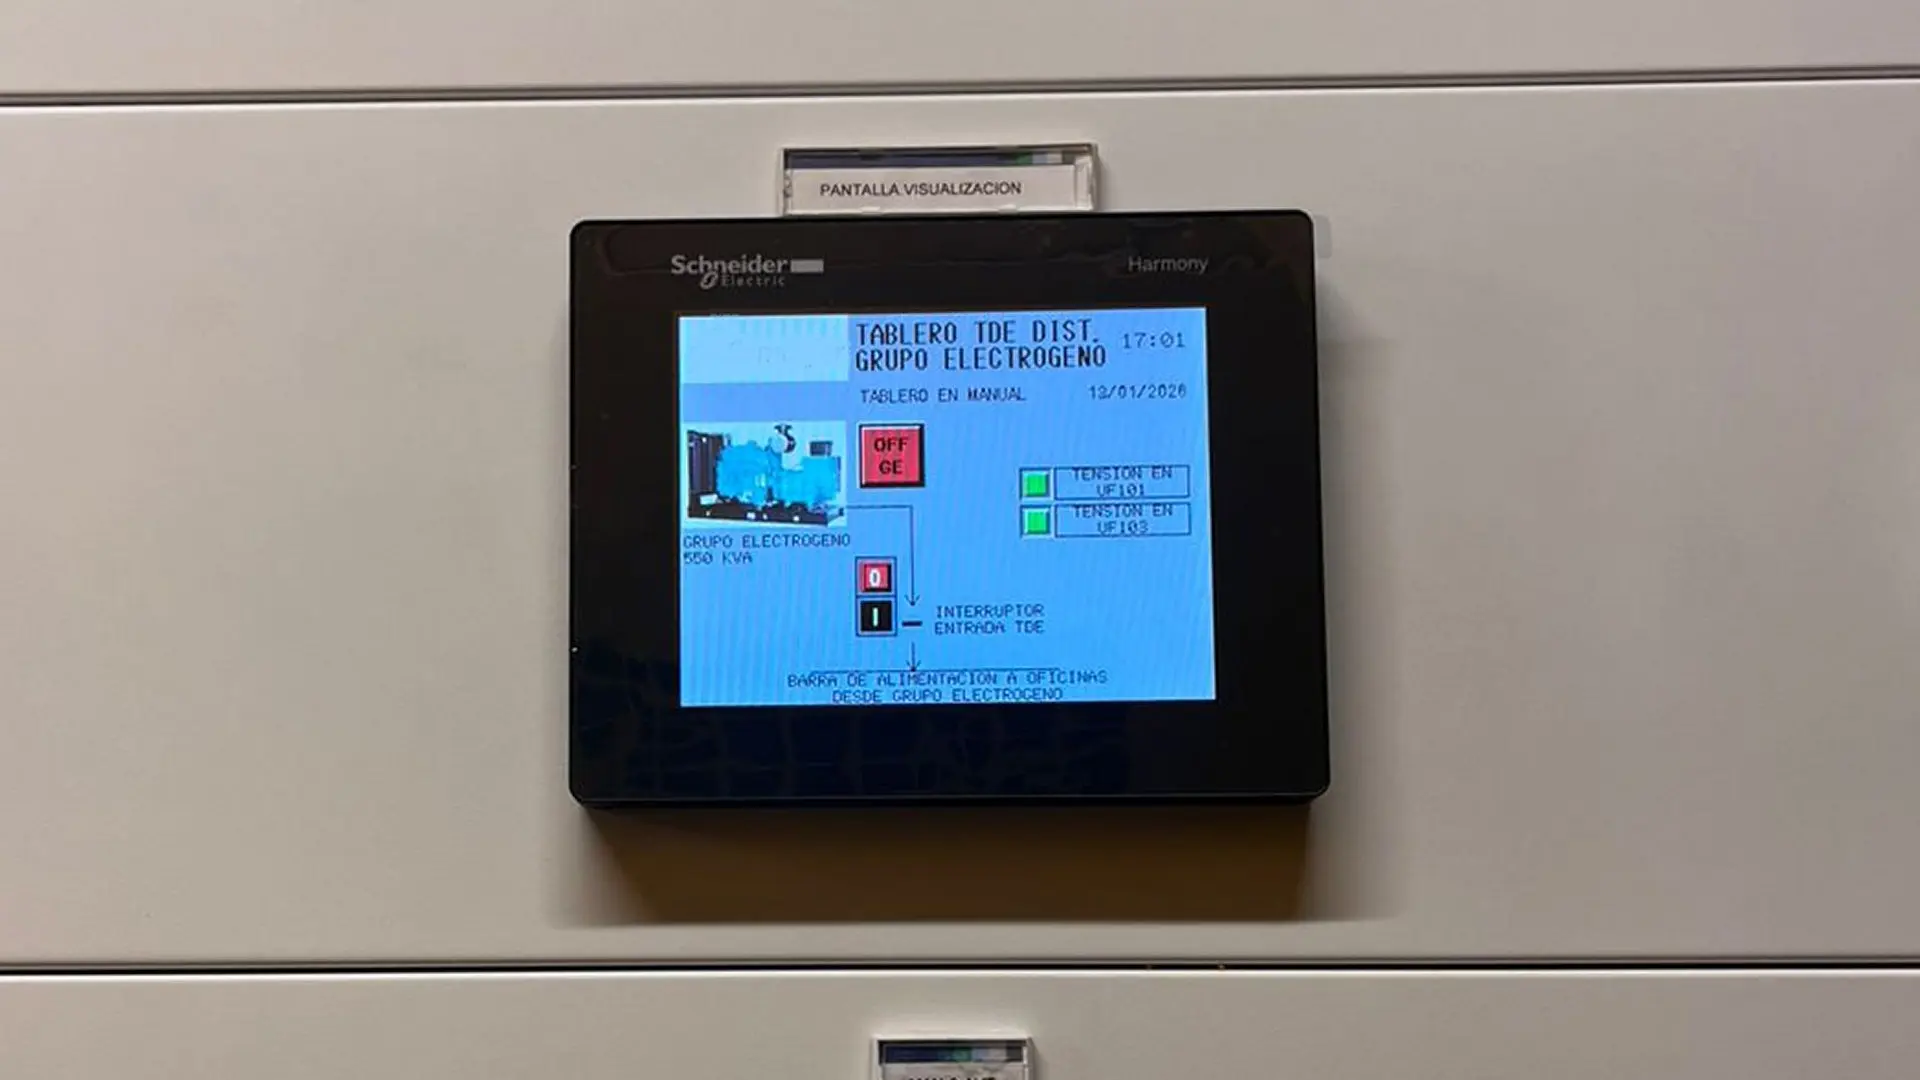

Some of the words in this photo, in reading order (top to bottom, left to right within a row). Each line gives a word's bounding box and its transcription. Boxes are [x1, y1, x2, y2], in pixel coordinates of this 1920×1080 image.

[820, 182, 899, 197] PANTALLA
[903, 181, 1022, 196] VISUALIZACION
[671, 254, 788, 274] Schneider
[1128, 256, 1209, 275] Harmony
[721, 274, 785, 287] Electric
[856, 322, 957, 346] TABLERO
[975, 320, 1017, 344] TDE
[1032, 319, 1099, 344] DIST.
[1122, 332, 1186, 350] 17:01
[855, 348, 928, 372] GRUPO
[943, 345, 1106, 371] ELECTROGENO
[860, 388, 928, 404] TABLERO
[938, 388, 958, 403] EN
[967, 387, 1026, 402] MANUAL
[874, 436, 908, 452] OFF
[879, 459, 903, 475] GE
[1072, 466, 1142, 481] TENSION
[1152, 465, 1173, 479] EN
[1072, 504, 1143, 518] TENSION
[1153, 503, 1173, 517] EN
[683, 535, 734, 549] GRUPO
[742, 533, 851, 549] ELECTROGENO
[683, 551, 713, 565] 550
[722, 551, 753, 565] KVA
[936, 603, 1045, 619] INTERRUPTOR
[934, 620, 1006, 635] ENTRADA
[787, 673, 837, 687] BARRA
[892, 688, 942, 702] GRUPO
[952, 687, 1064, 702] ELECTROGENO
